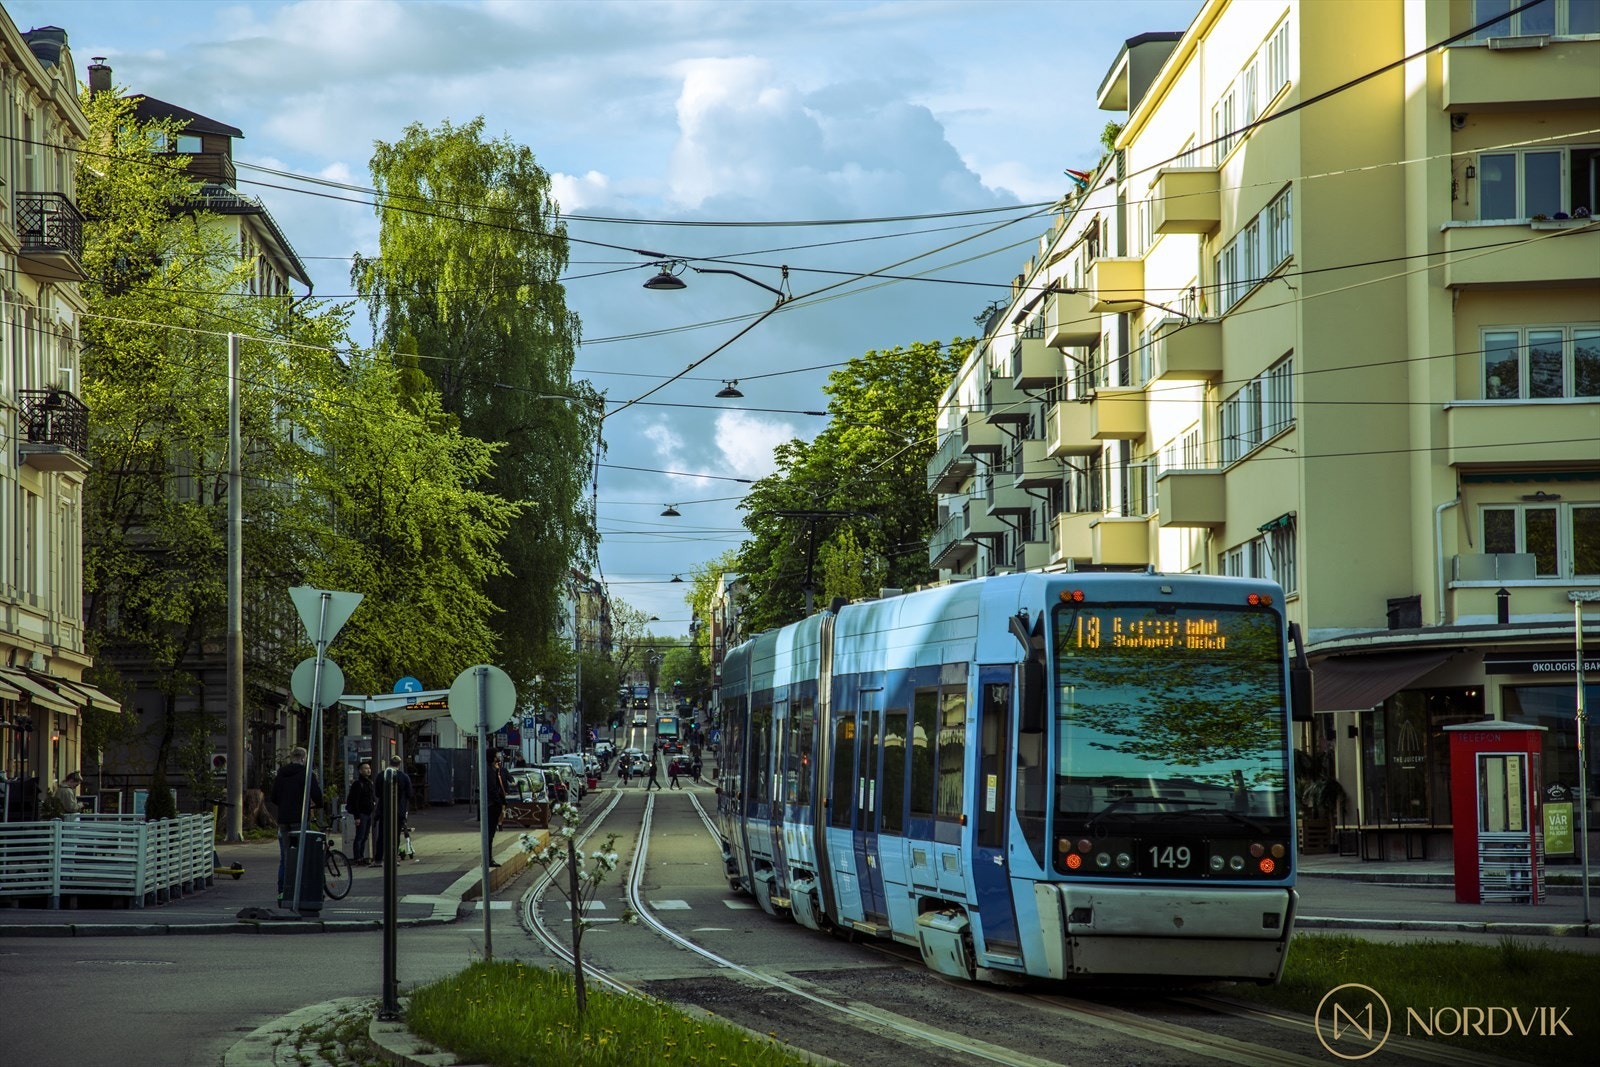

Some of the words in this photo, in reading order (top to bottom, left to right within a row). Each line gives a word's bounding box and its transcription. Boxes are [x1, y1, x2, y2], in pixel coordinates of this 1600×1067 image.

[1532, 662, 1582, 672] ØKOLOGIS
[404, 682, 414, 692] 5
[1458, 733, 1501, 743] TELEFON
[1549, 813, 1567, 825] VÅR
[1149, 846, 1191, 868] 149
